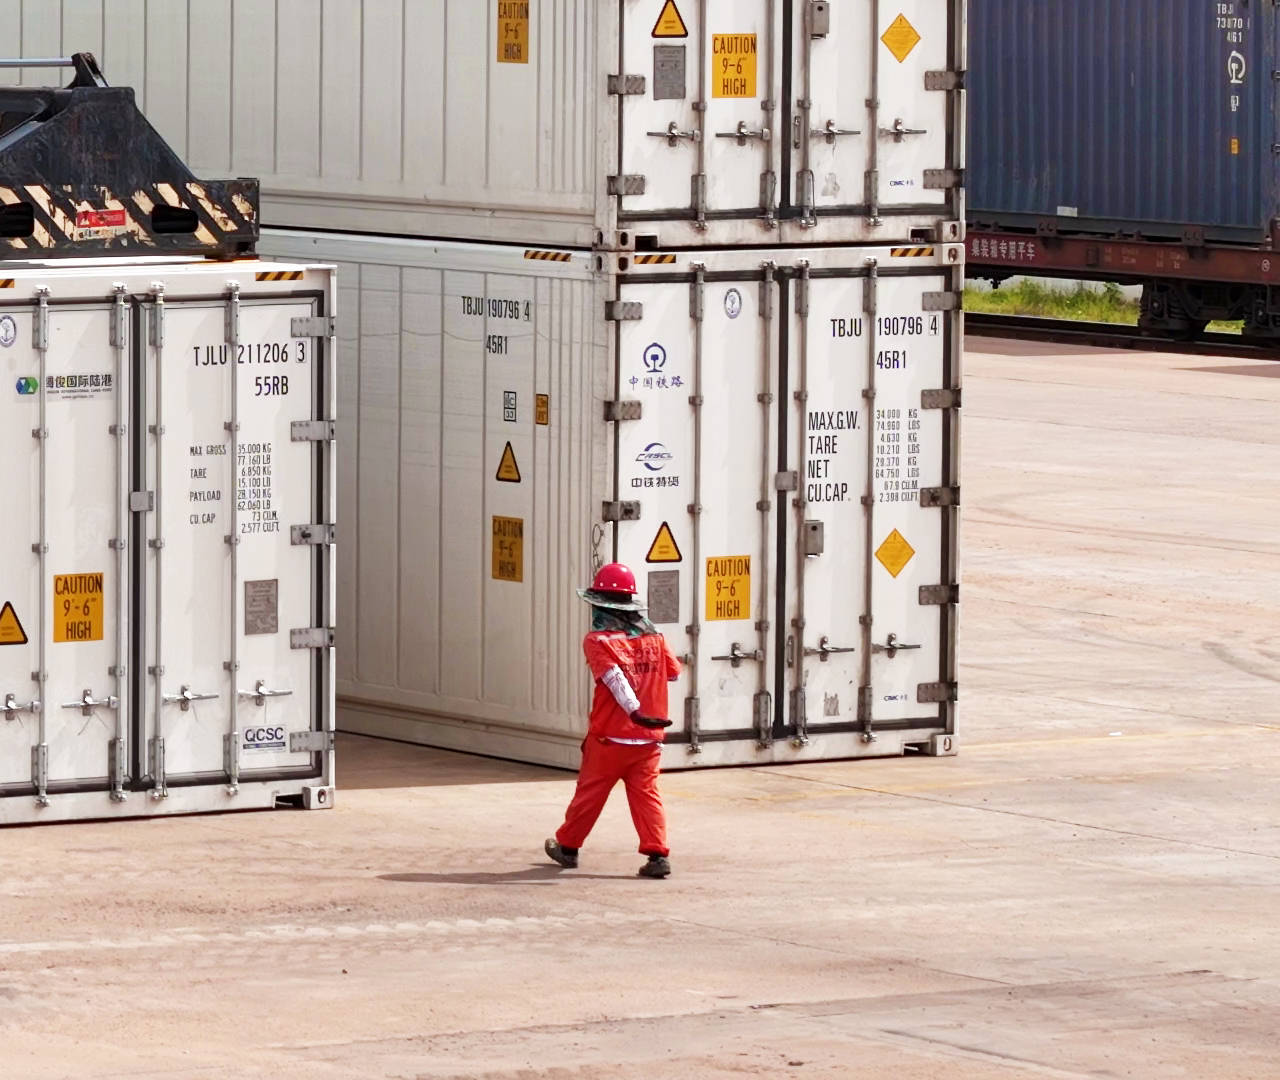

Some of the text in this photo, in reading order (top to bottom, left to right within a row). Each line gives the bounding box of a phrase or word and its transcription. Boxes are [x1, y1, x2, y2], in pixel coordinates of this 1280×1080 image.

[498, 1, 529, 20] CAUTION
[504, 42, 522, 60] HIGH
[713, 36, 757, 54] CAUTION
[722, 78, 746, 95] HIGH
[461, 295, 484, 316] TBJU
[487, 298, 520, 320] 190796
[830, 316, 938, 338] TBJU 190796 4
[193, 342, 305, 366] TJLU 211206 3
[486, 334, 508, 355] 45R1
[876, 350, 907, 370] 45R1
[255, 376, 289, 396] 55RB
[628, 375, 684, 391] 中国铁路
[262, 443, 272, 453] KG
[808, 435, 838, 455] TARE
[262, 454, 271, 464] LB
[190, 468, 207, 479] TARE
[262, 466, 272, 476] KG
[808, 459, 830, 479] NET
[189, 490, 221, 502] PAYLOAD
[262, 488, 272, 498] KG
[262, 500, 271, 510] LB
[493, 517, 524, 539] CAUTION
[706, 558, 750, 577] CAUTION
[55, 575, 103, 595] CAUTION
[716, 600, 740, 618] HIGH
[66, 620, 92, 640] HIGH
